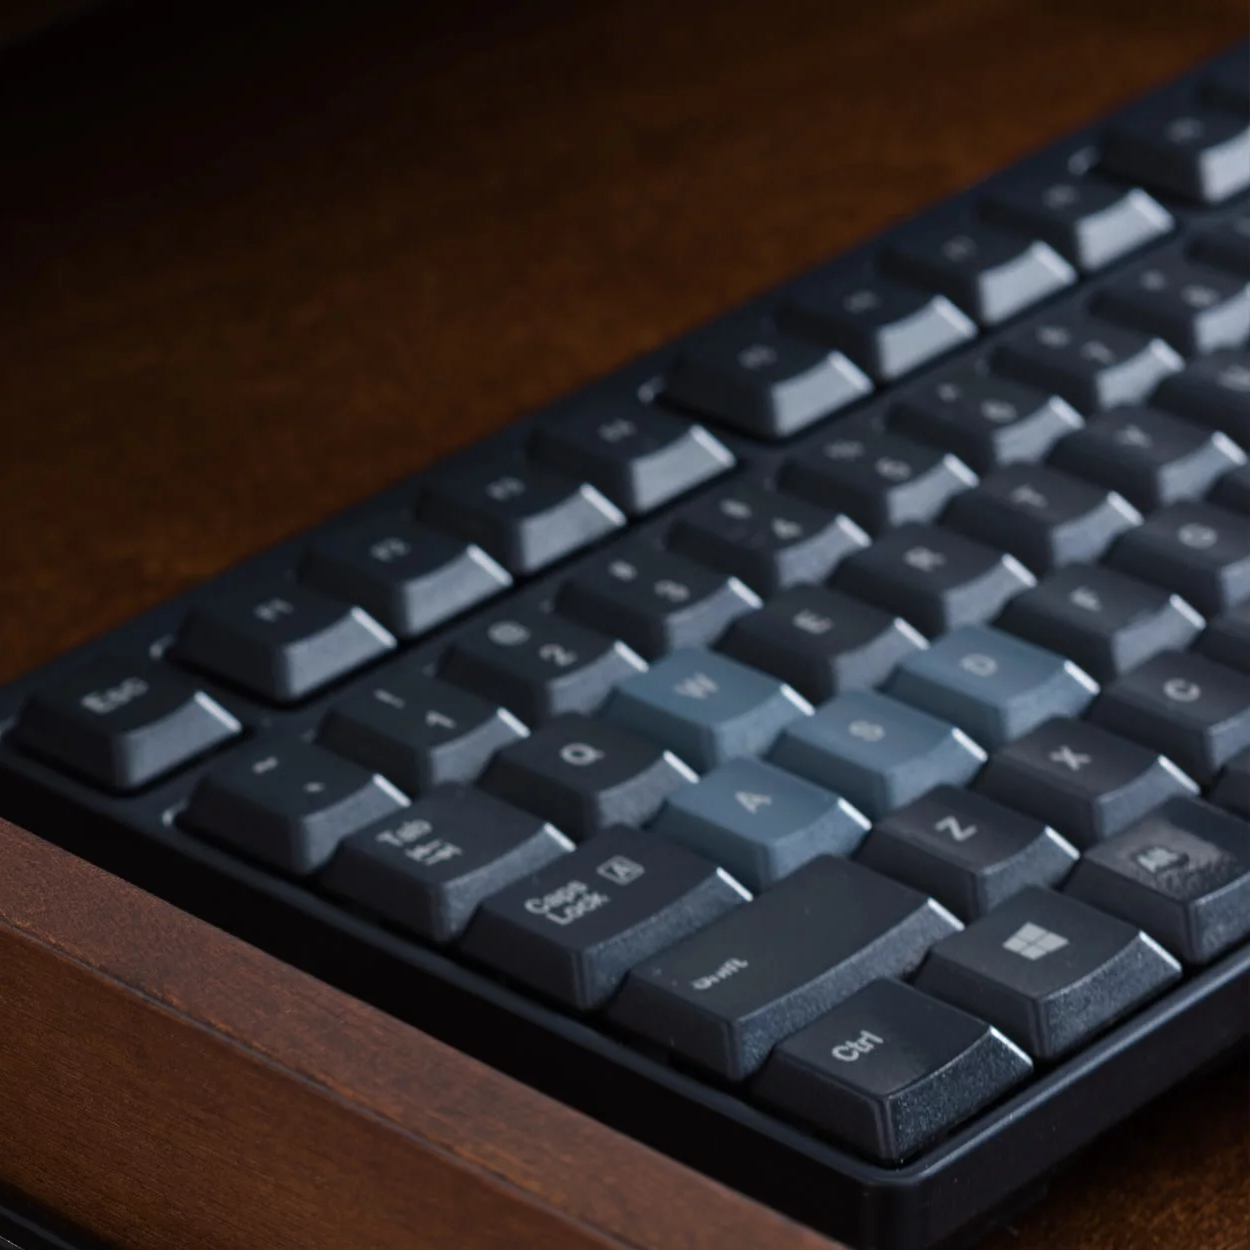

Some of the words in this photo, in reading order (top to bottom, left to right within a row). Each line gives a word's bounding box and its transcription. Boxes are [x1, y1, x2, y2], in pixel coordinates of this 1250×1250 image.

[1162, 679, 1201, 703] C
[559, 742, 604, 766] Q
[1050, 746, 1090, 771] X
[734, 790, 772, 815] A
[374, 819, 433, 847] Tab
[935, 816, 977, 842] Z
[524, 880, 588, 914] Caps
[546, 891, 609, 925] Lock
[831, 1030, 884, 1062] Ctrl
